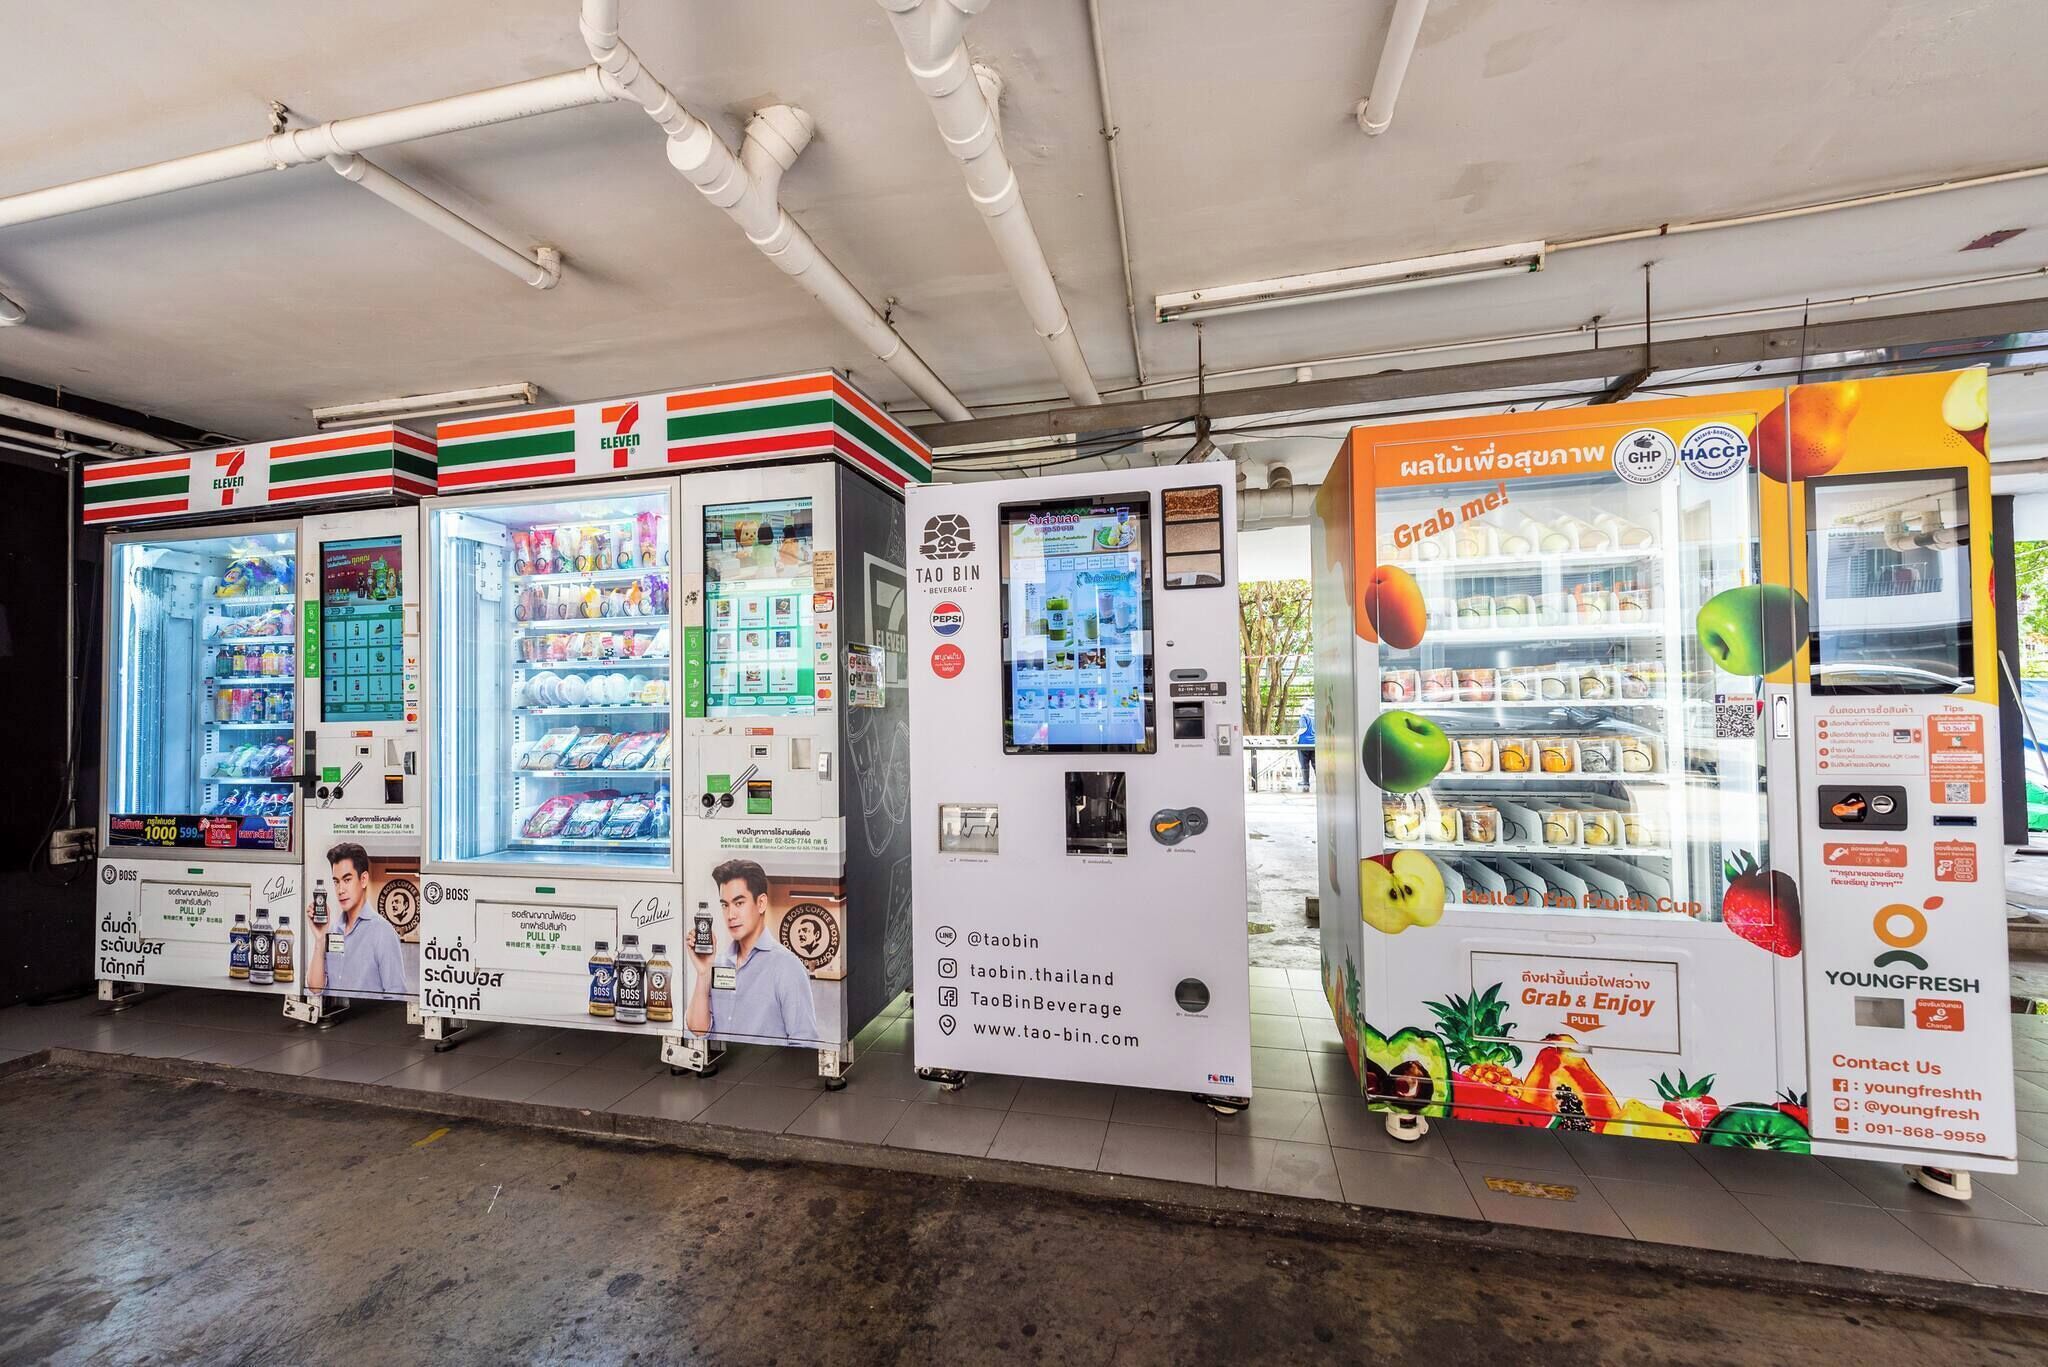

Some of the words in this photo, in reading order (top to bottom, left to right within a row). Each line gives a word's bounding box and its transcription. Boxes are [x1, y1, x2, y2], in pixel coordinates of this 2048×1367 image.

[600, 434, 640, 450] ELEVEN
[602, 401, 638, 468] 7
[1400, 443, 1605, 478] ผลไม้เพื่อสุขภาพ
[1628, 450, 1661, 464] GHP
[1680, 444, 1748, 461] HACCP
[1627, 473, 1653, 482] HYGIENIC
[1654, 458, 1672, 480] PRACTICE
[213, 476, 244, 490] ELEVEN
[1394, 508, 1455, 549] Grab
[1460, 482, 1509, 521] me!
[916, 567, 943, 584] TAO
[953, 565, 980, 581] BIN
[929, 585, 968, 594] BEVERAGE
[932, 614, 962, 624] PEPSI
[1943, 705, 1964, 713] Tips
[144, 826, 178, 841] 1000
[179, 827, 198, 838] 599
[736, 828, 811, 837] พบปัญหาการใช้งานติดต่อ
[118, 871, 137, 881] BOSS
[168, 888, 219, 898] รอสัญญาณไฟเขียว
[445, 888, 469, 901] BOSS
[179, 906, 194, 915] PULL
[197, 907, 207, 915] UP
[1462, 889, 1516, 906] Hello
[1543, 892, 1575, 908] I'm
[1656, 896, 1702, 916] Cup
[511, 909, 577, 921] รอสัญญาณไฟเขียว
[787, 906, 804, 922] BOSS
[805, 905, 831, 924] COFFEE
[520, 921, 567, 932] ยกฝารับสินค้า
[526, 931, 546, 942] PULL
[549, 932, 560, 943] UP
[697, 932, 710, 941] BOSS
[967, 931, 1039, 949] @taobin
[101, 938, 165, 955] ระดับบอส
[232, 953, 246, 962] BOSS
[253, 955, 269, 964] BOSS
[276, 955, 290, 964] BOSS
[100, 956, 145, 979] ได้ทุกที่
[970, 963, 1114, 986] taobin.thailand
[424, 965, 504, 988] ระดับบอส
[1521, 970, 1651, 991] ดึงฝาขึ้นเมื่อไฟสว่าง
[1825, 970, 1980, 994] YOUNGFRESH
[593, 986, 610, 997] BOSS
[619, 989, 640, 1000] BOSS
[649, 990, 668, 1001] BOSS
[424, 987, 481, 1014] ได้ทุกที่
[970, 992, 1122, 1018] TaoBinBeverage
[1521, 988, 1571, 1008] Grab
[1575, 995, 1587, 1007] &
[1593, 992, 1656, 1016] Enjoy
[1571, 1015, 1598, 1026] PULL
[1926, 1022, 1952, 1030] Change
[973, 1022, 1139, 1048] www.tao-bin.com
[1832, 1054, 1910, 1073] Contact
[1916, 1060, 1942, 1075] Us
[1864, 1081, 1982, 1101] youngfreshth
[1864, 1100, 1980, 1121] @youngfresh
[1865, 1122, 1986, 1144] 091-868-9959
